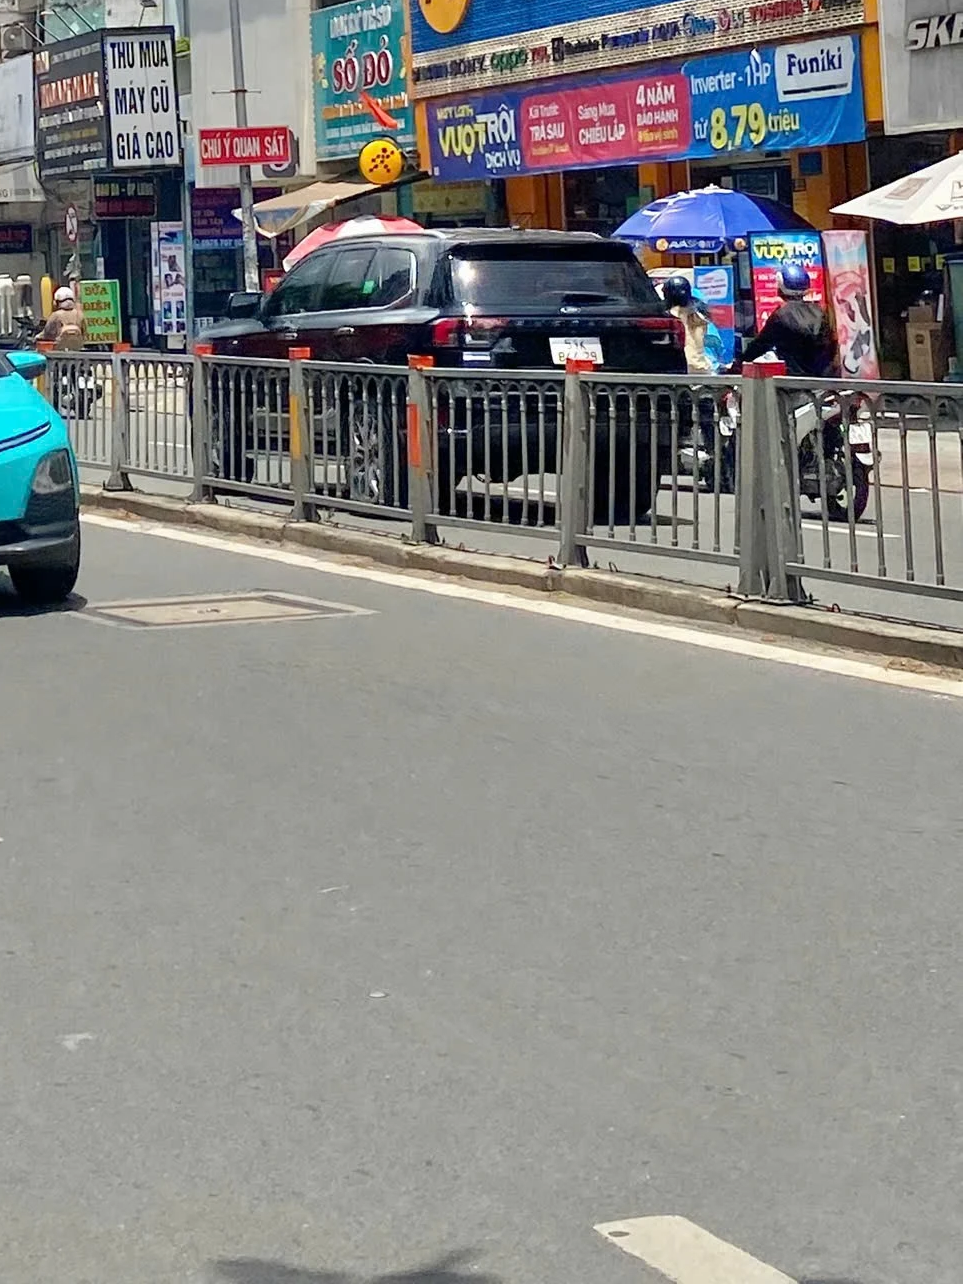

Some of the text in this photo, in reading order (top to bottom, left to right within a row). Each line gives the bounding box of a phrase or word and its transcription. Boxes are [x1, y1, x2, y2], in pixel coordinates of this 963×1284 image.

[110, 41, 135, 69] THU
[140, 40, 169, 68] MUA
[787, 46, 843, 77] Funiki
[114, 80, 145, 115] MÁY
[151, 79, 170, 114] CŨ
[636, 81, 675, 107] 4 NĂM
[690, 69, 737, 96] Inverter
[546, 122, 565, 139] SAU
[768, 108, 800, 136] triệu
[117, 125, 142, 160] GIÁ
[146, 131, 174, 158] CAO
[201, 130, 285, 159] CHÚ Ý QUAN SÁT
